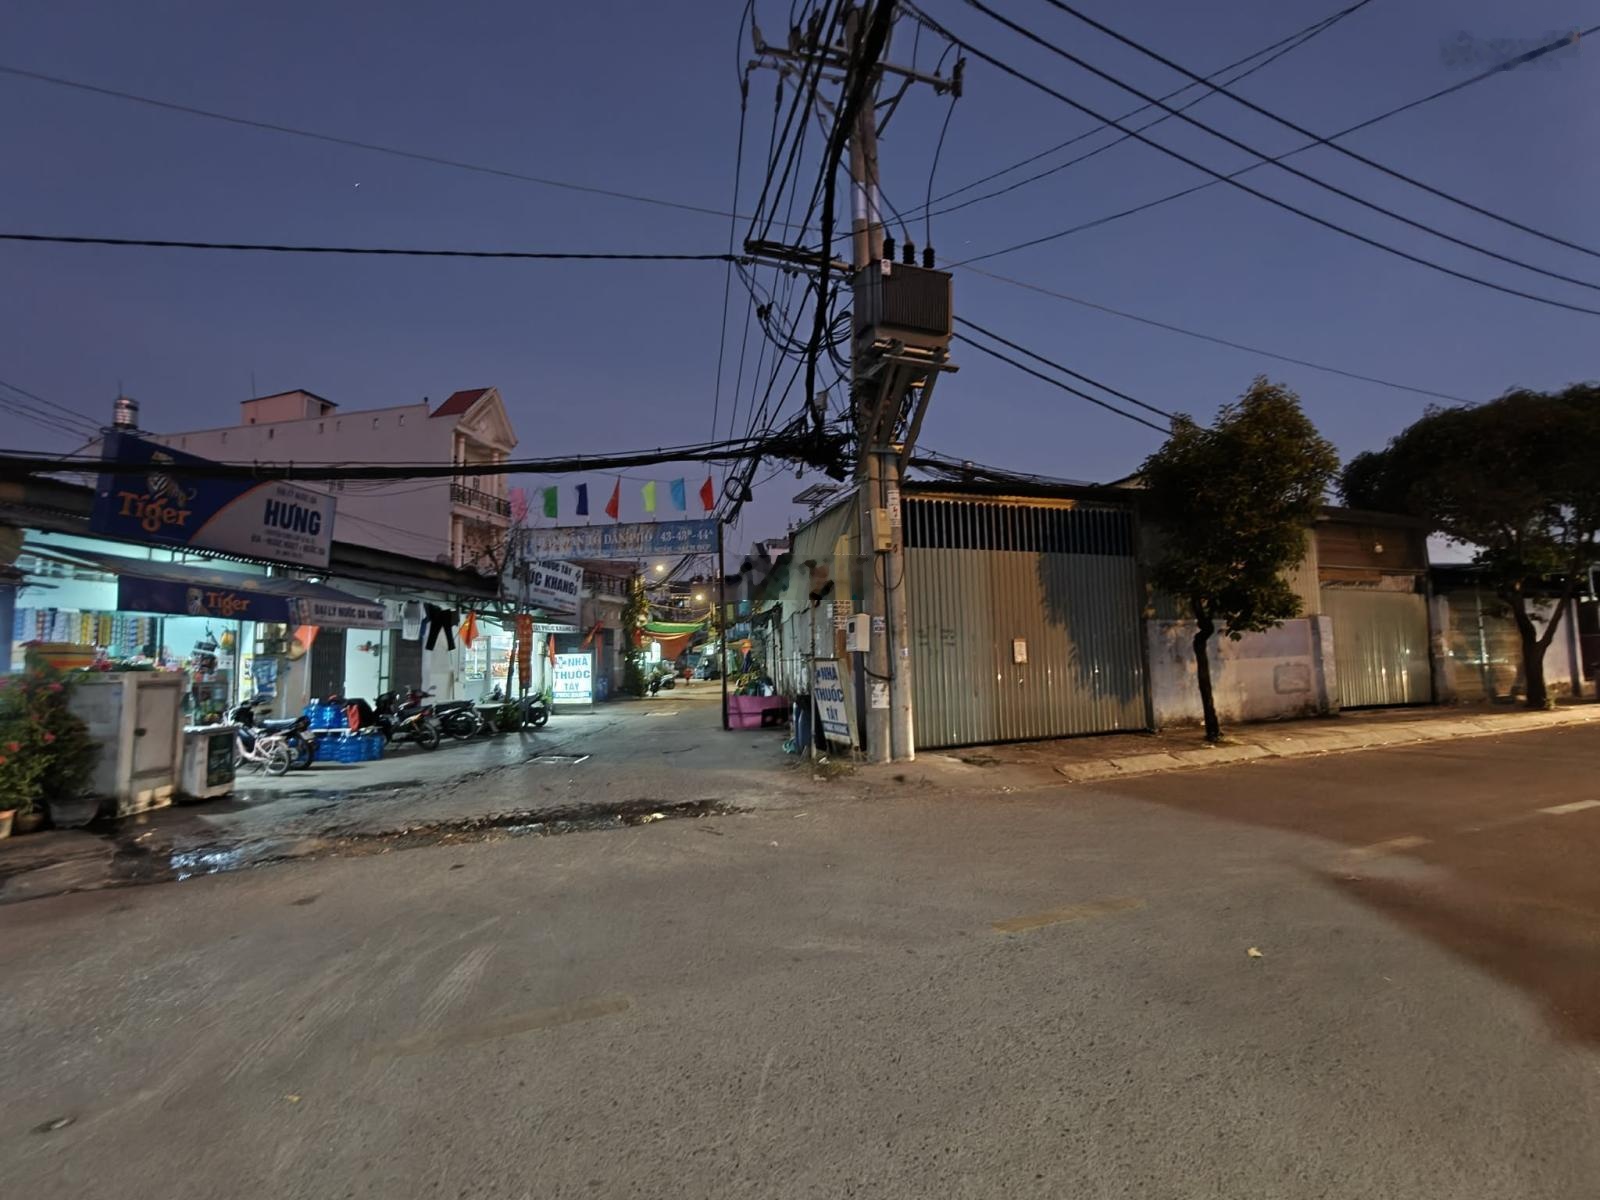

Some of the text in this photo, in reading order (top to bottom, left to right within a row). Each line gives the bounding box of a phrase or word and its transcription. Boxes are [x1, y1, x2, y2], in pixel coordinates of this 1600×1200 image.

[117, 491, 192, 532] Tiger
[264, 499, 321, 536] HƯNG
[206, 591, 249, 616] Tiger
[567, 656, 588, 667] NHÀ
[820, 663, 838, 681] NHÀ
